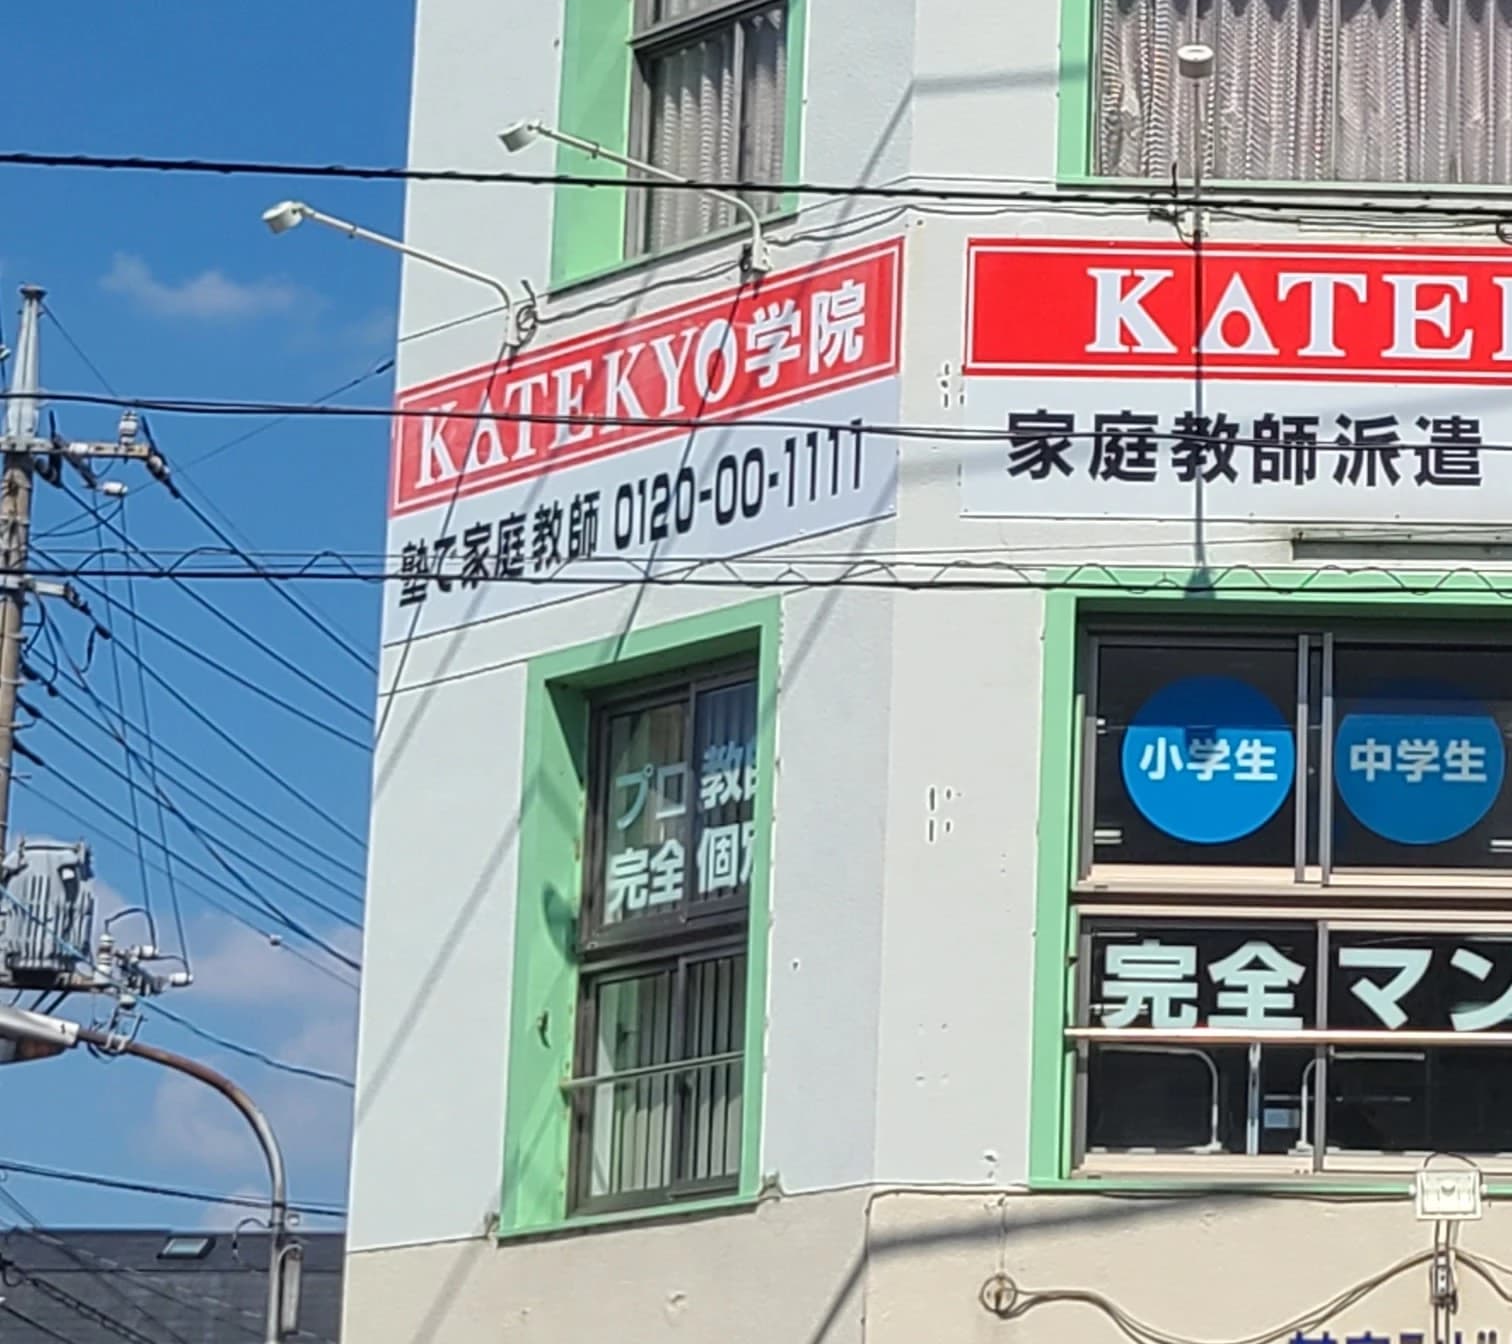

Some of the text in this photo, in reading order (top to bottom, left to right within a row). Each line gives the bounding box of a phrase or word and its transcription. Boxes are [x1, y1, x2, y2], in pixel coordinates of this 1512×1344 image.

[1007, 408, 1484, 490] 家庭教師派遣
[399, 419, 867, 607] 塾で家庭教師 0120-00-1111
[1139, 737, 1279, 784] 小学生
[1349, 738, 1488, 785] 中学生
